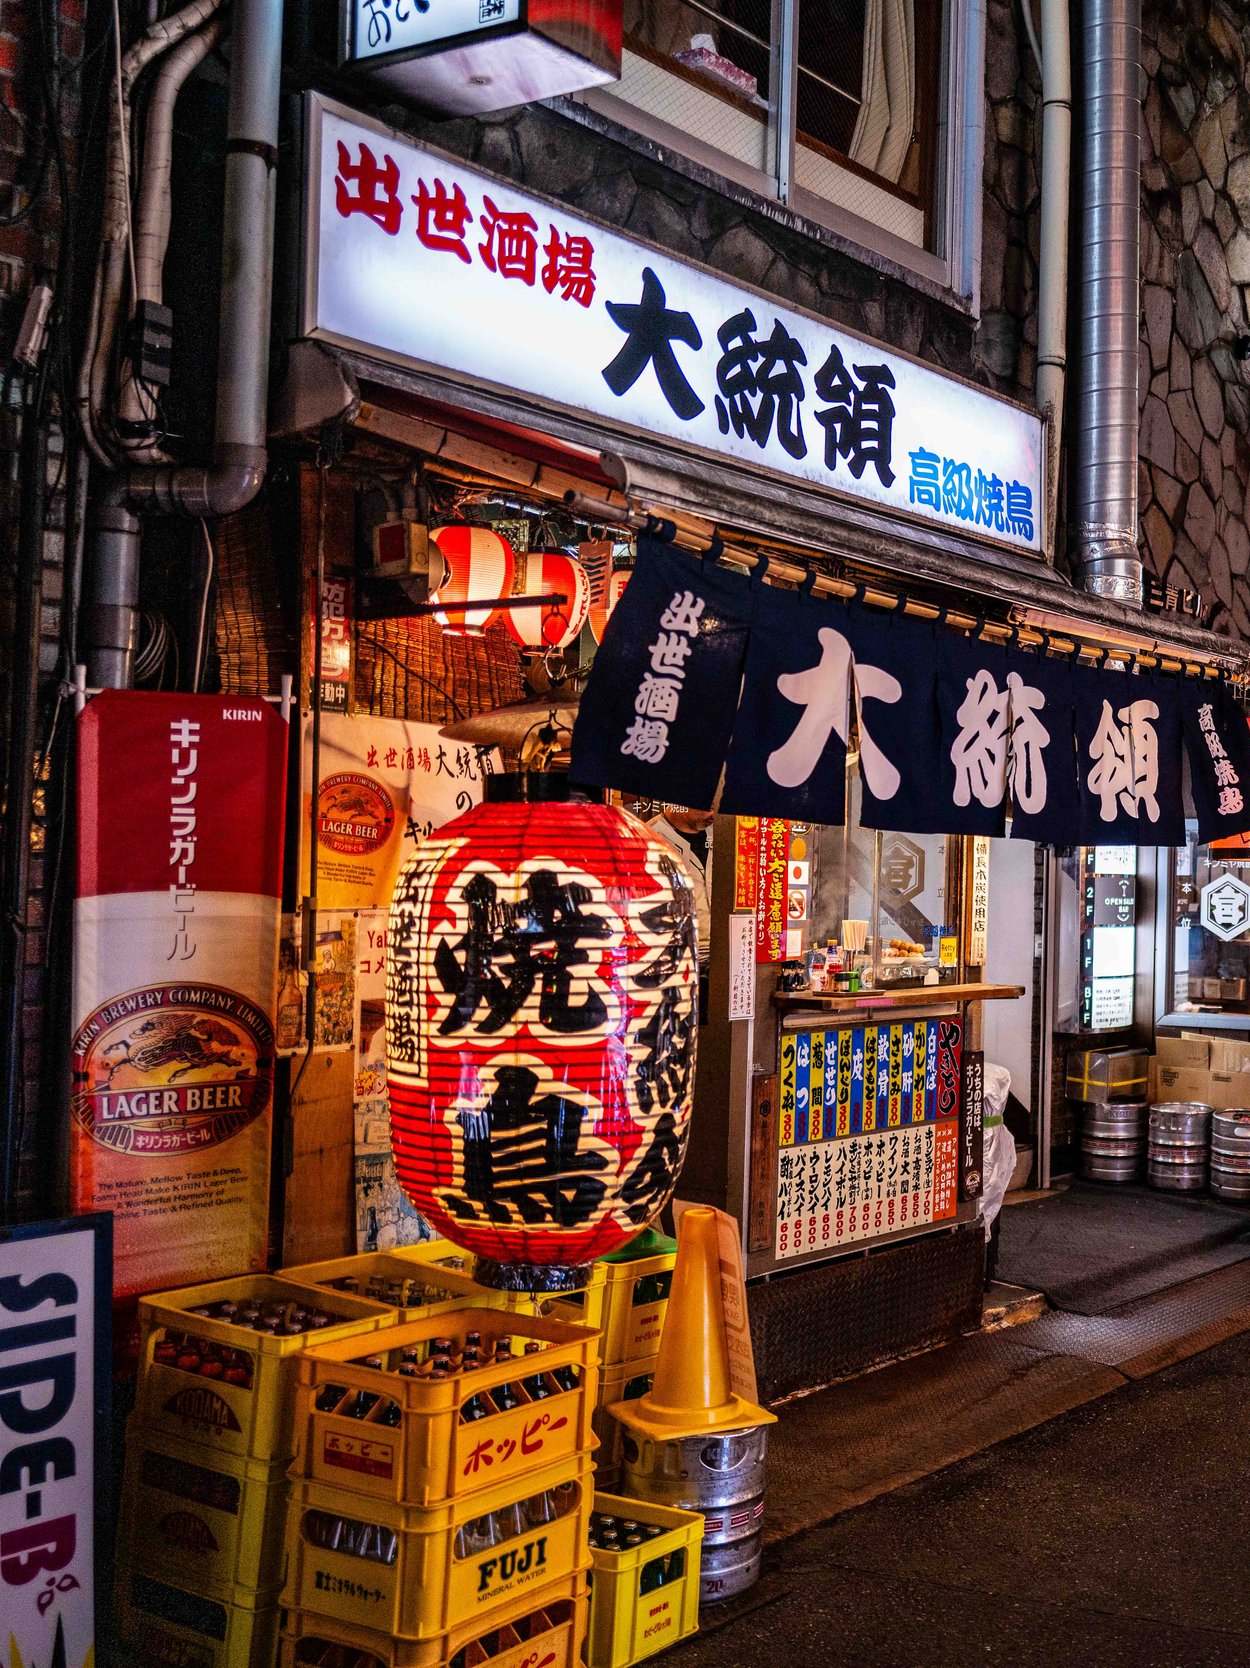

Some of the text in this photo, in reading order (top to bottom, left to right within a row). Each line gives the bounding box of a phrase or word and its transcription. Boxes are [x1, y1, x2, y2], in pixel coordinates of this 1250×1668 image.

[335, 138, 1035, 542] 出世酒場 大統領 高級焼鳥
[222, 708, 263, 722] KIRIN
[620, 589, 1245, 824] 出世酒場 大統領 高級焼鳥
[366, 744, 432, 773] 出世酒場
[166, 718, 201, 961] キリンラガービール
[322, 820, 378, 840] LAGER BEER
[404, 816, 438, 846] キリ
[74, 1018, 101, 1058] KIRIN
[101, 991, 165, 1024] BREWERY
[236, 1004, 275, 1047] LIMITED
[431, 868, 615, 1228] 焼鳥
[796, 1042, 811, 1109] はつ
[824, 1041, 838, 1106] せせり
[850, 1049, 864, 1081] 皮
[877, 1034, 890, 1097] 軟骨
[889, 1034, 901, 1122] ささみ 300
[901, 1032, 915, 1094] 砂肝
[914, 1029, 926, 1117] かしわ 300
[938, 1021, 962, 1115] やきとり
[101, 1084, 243, 1121] LAGER BEER
[781, 1044, 796, 1140] つくね 300
[865, 1101, 873, 1126] 300
[965, 1063, 974, 1168] キリンラガービール
[973, 1063, 982, 1131] うちの店は、
[135, 1127, 211, 1149] キリンラガービール
[811, 1109, 821, 1137] 300
[839, 1105, 847, 1131] 300
[119, 1190, 143, 1199] Head
[144, 1186, 171, 1195] Make
[172, 1182, 201, 1192] KIRIN
[203, 1178, 229, 1190] Lager
[230, 1175, 249, 1184] Beer
[186, 1171, 211, 1180] Taste
[862, 1139, 874, 1188] ホッピー
[874, 1138, 887, 1228] ホッピー 700
[887, 1135, 900, 1226] ワイン 650
[125, 1196, 171, 1209] Wonderful
[173, 1191, 214, 1203] Harmony
[143, 1207, 168, 1216] Taste
[178, 1200, 214, 1212] Refined
[794, 1153, 807, 1248] バイスハイ 600
[807, 1150, 821, 1245] ウーロンハイ 600
[820, 1149, 834, 1241] レモンハイ 600
[835, 1146, 848, 1237] ハイボール 600
[900, 1194, 908, 1222] 650
[912, 1192, 920, 1218] 650
[923, 1190, 932, 1216] 700
[780, 1222, 789, 1251] 600
[849, 1206, 857, 1232] 700
[861, 1203, 870, 1231] 600
[328, 1437, 390, 1458] ホッピー
[463, 1413, 568, 1476] ホッピー
[315, 1570, 387, 1602] 富士ミネラルウォーター
[477, 1536, 549, 1593] FUJI
[477, 1566, 547, 1604] MINERAL WATER
